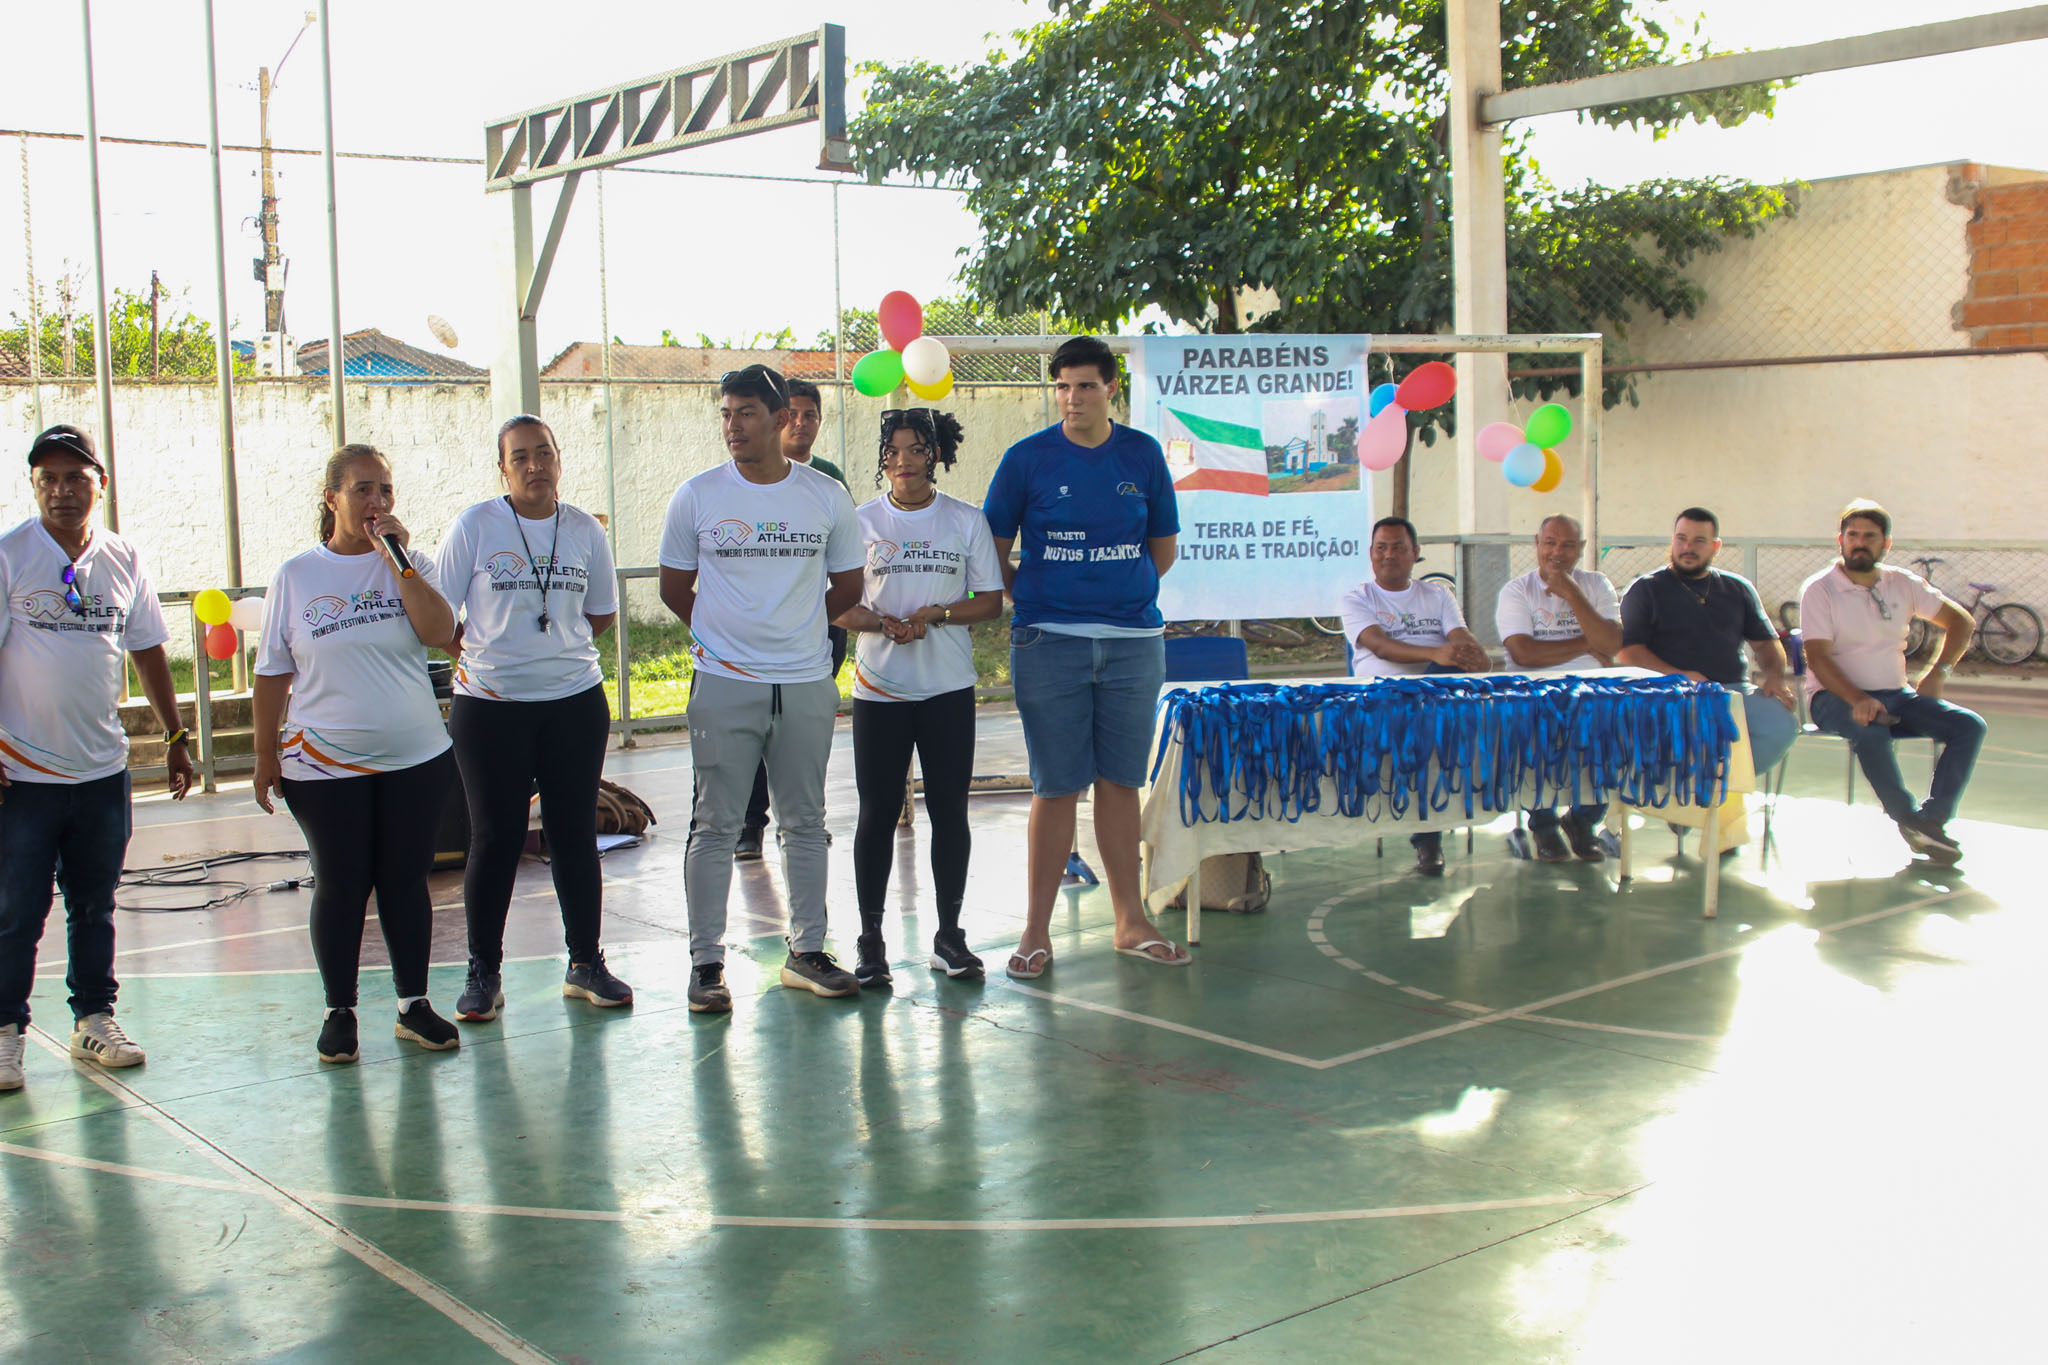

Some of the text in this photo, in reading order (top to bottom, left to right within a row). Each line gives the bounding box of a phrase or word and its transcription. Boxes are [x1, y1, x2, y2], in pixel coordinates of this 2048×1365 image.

[1183, 342, 1330, 369] PARABÉNS
[1156, 370, 1353, 395] VÁRZEA GRANDE!
[1195, 516, 1319, 539] TERRA DE FÉ,
[757, 533, 822, 544] ATHLETICS
[1046, 530, 1086, 541] PROJETO
[715, 548, 743, 558] PRIMEIRO
[743, 548, 769, 557] FESTIVAL
[770, 548, 778, 557] DE
[779, 548, 791, 557] MINI
[1246, 542, 1256, 559] E
[1261, 536, 1359, 561] TRADIÇÃO!
[903, 550, 960, 562] ATHLETICS
[891, 564, 914, 574] FESTIVAL
[914, 564, 922, 573] DE
[492, 580, 517, 592] PRIMEIRO
[312, 621, 340, 641] PRIMEIRO
[340, 614, 370, 630] FESTIVAL
[370, 613, 380, 623] DE
